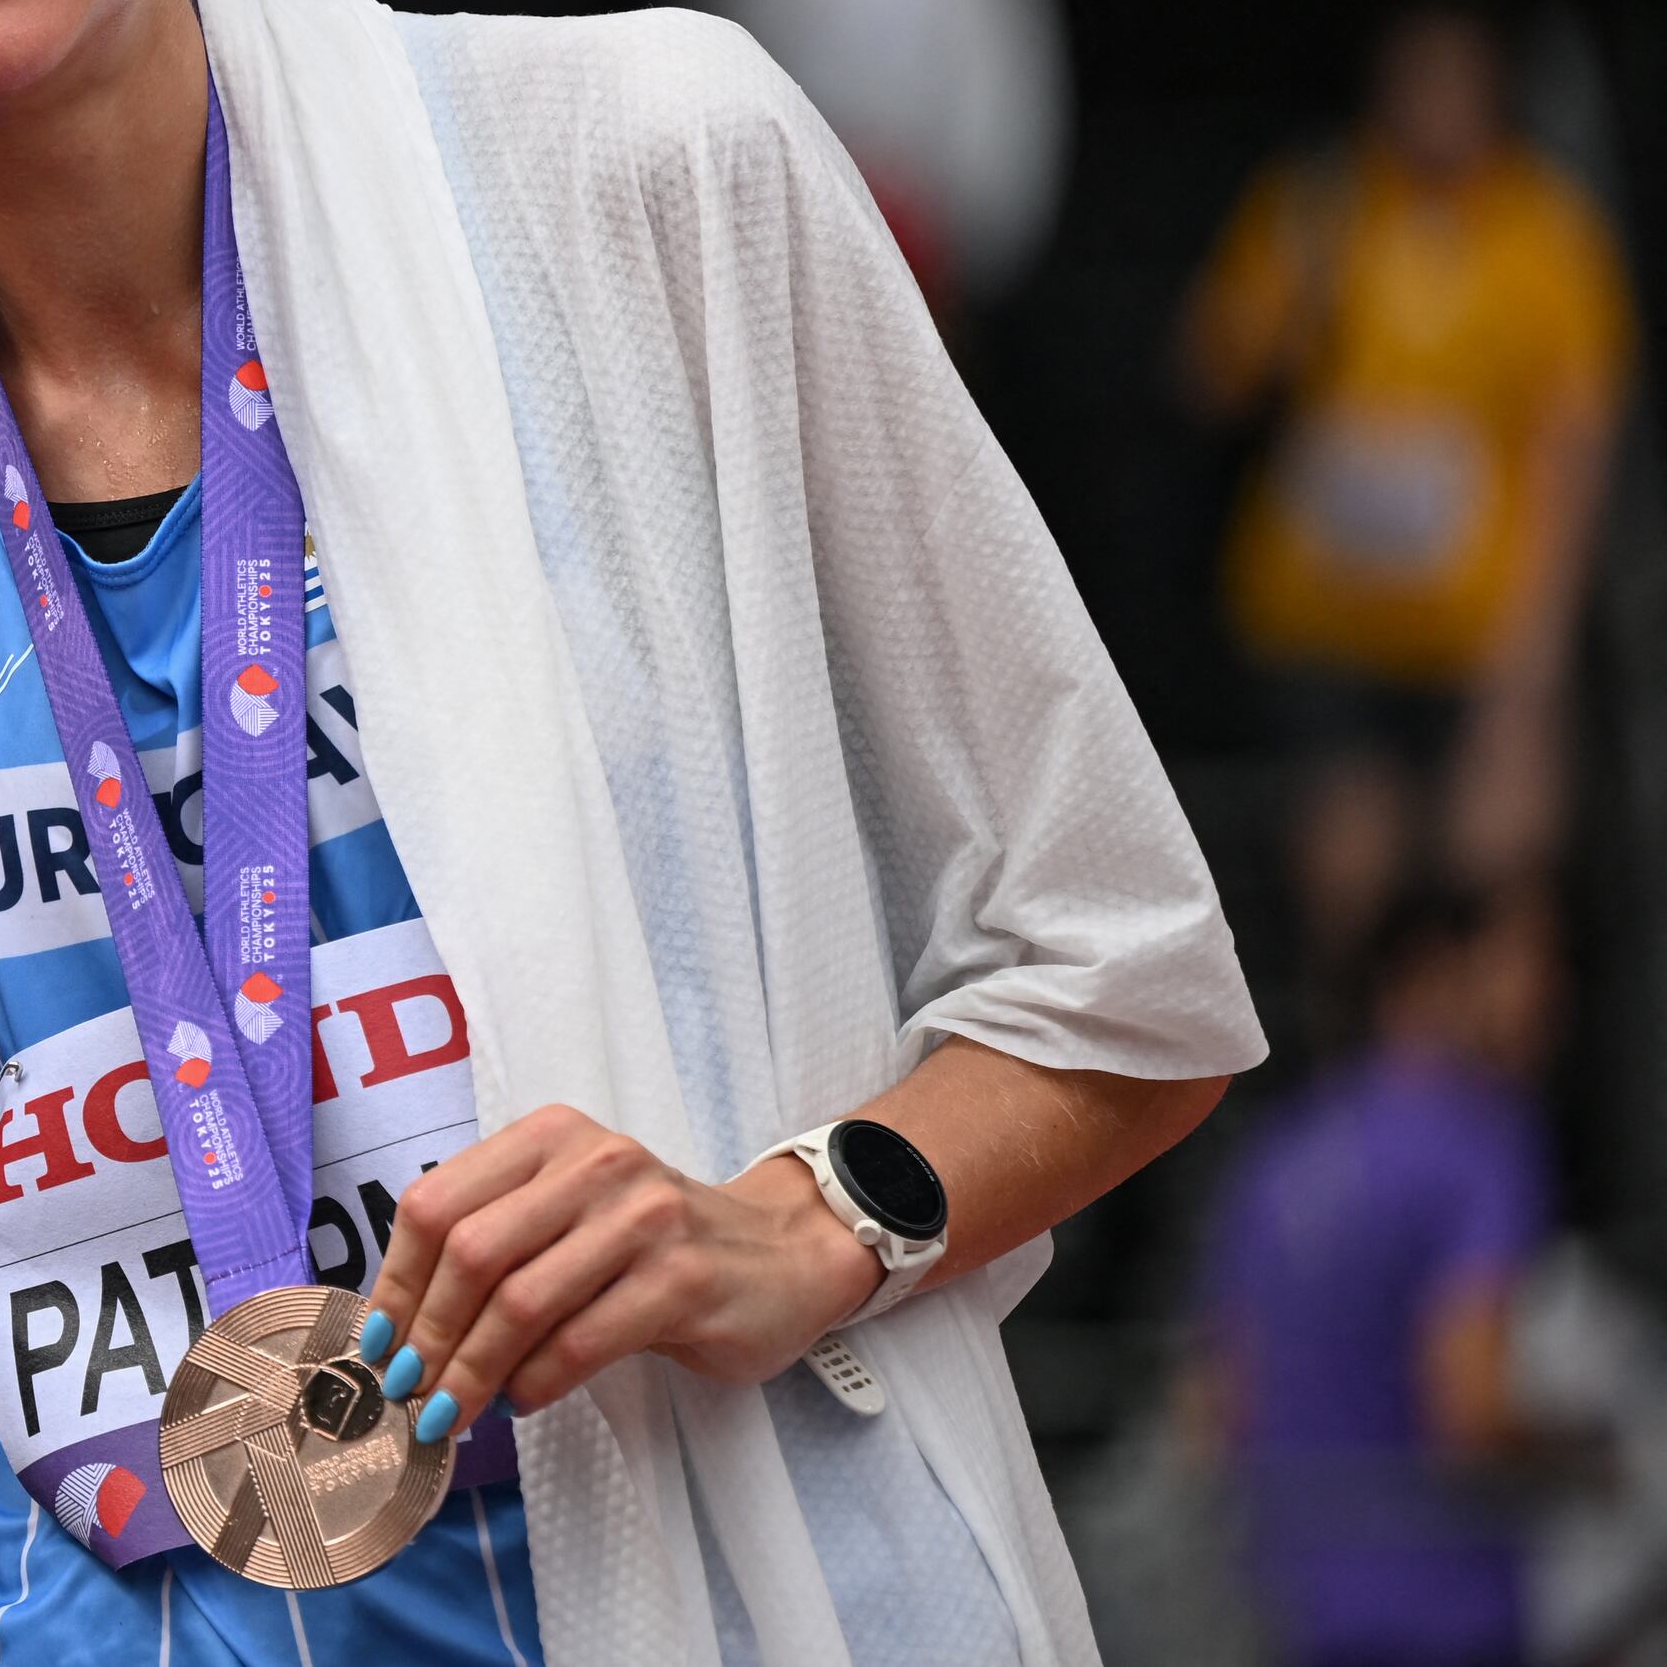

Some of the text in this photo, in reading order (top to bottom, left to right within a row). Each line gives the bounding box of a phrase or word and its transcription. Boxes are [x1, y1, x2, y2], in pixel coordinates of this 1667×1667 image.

[236, 313, 245, 350] WORLD
[27, 536, 60, 625] CHAMPIONSHIPS
[31, 529, 65, 620] WORLD ATHLETICS
[237, 559, 247, 655] WORLD ATHLETICS
[248, 558, 258, 655] CHAMPIONSHIPS
[114, 813, 149, 904] CHAMPIONSHIPS
[121, 807, 156, 899] WORLD ATHLETICS
[240, 866, 250, 964] WORLD ATHLETICS
[251, 866, 262, 963] CHAMPIONSHIPS
[198, 1093, 234, 1186] CHAMPIONSHIPS
[208, 1089, 244, 1182] WORLD ATHLETICS
